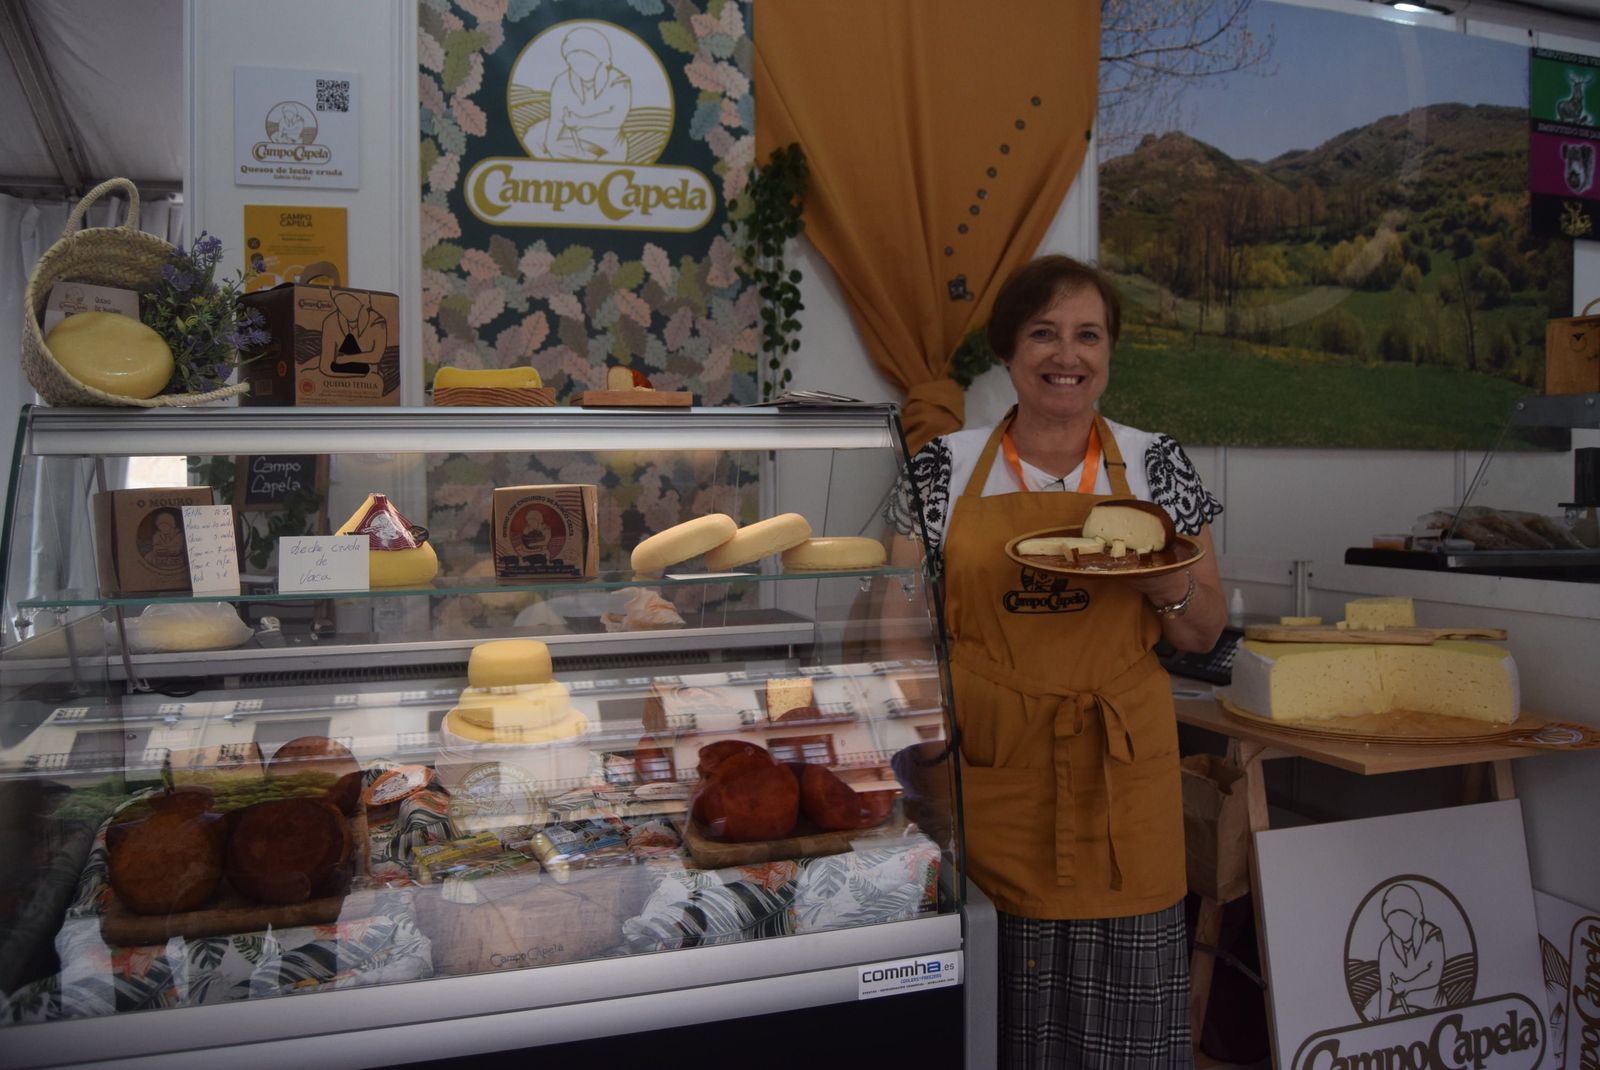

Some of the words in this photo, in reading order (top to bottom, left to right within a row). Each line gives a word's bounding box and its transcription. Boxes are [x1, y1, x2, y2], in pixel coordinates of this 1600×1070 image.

[240, 165, 273, 174] Quesos
[276, 166, 287, 174] de
[289, 167, 313, 176] leche
[280, 212, 312, 221] CAMPO
[280, 219, 313, 228] CAPELA
[323, 380, 351, 390] QUEIXO
[352, 381, 379, 390] TETILLA
[253, 455, 302, 478] Campo
[251, 474, 301, 498] Capela
[315, 552, 328, 566] de
